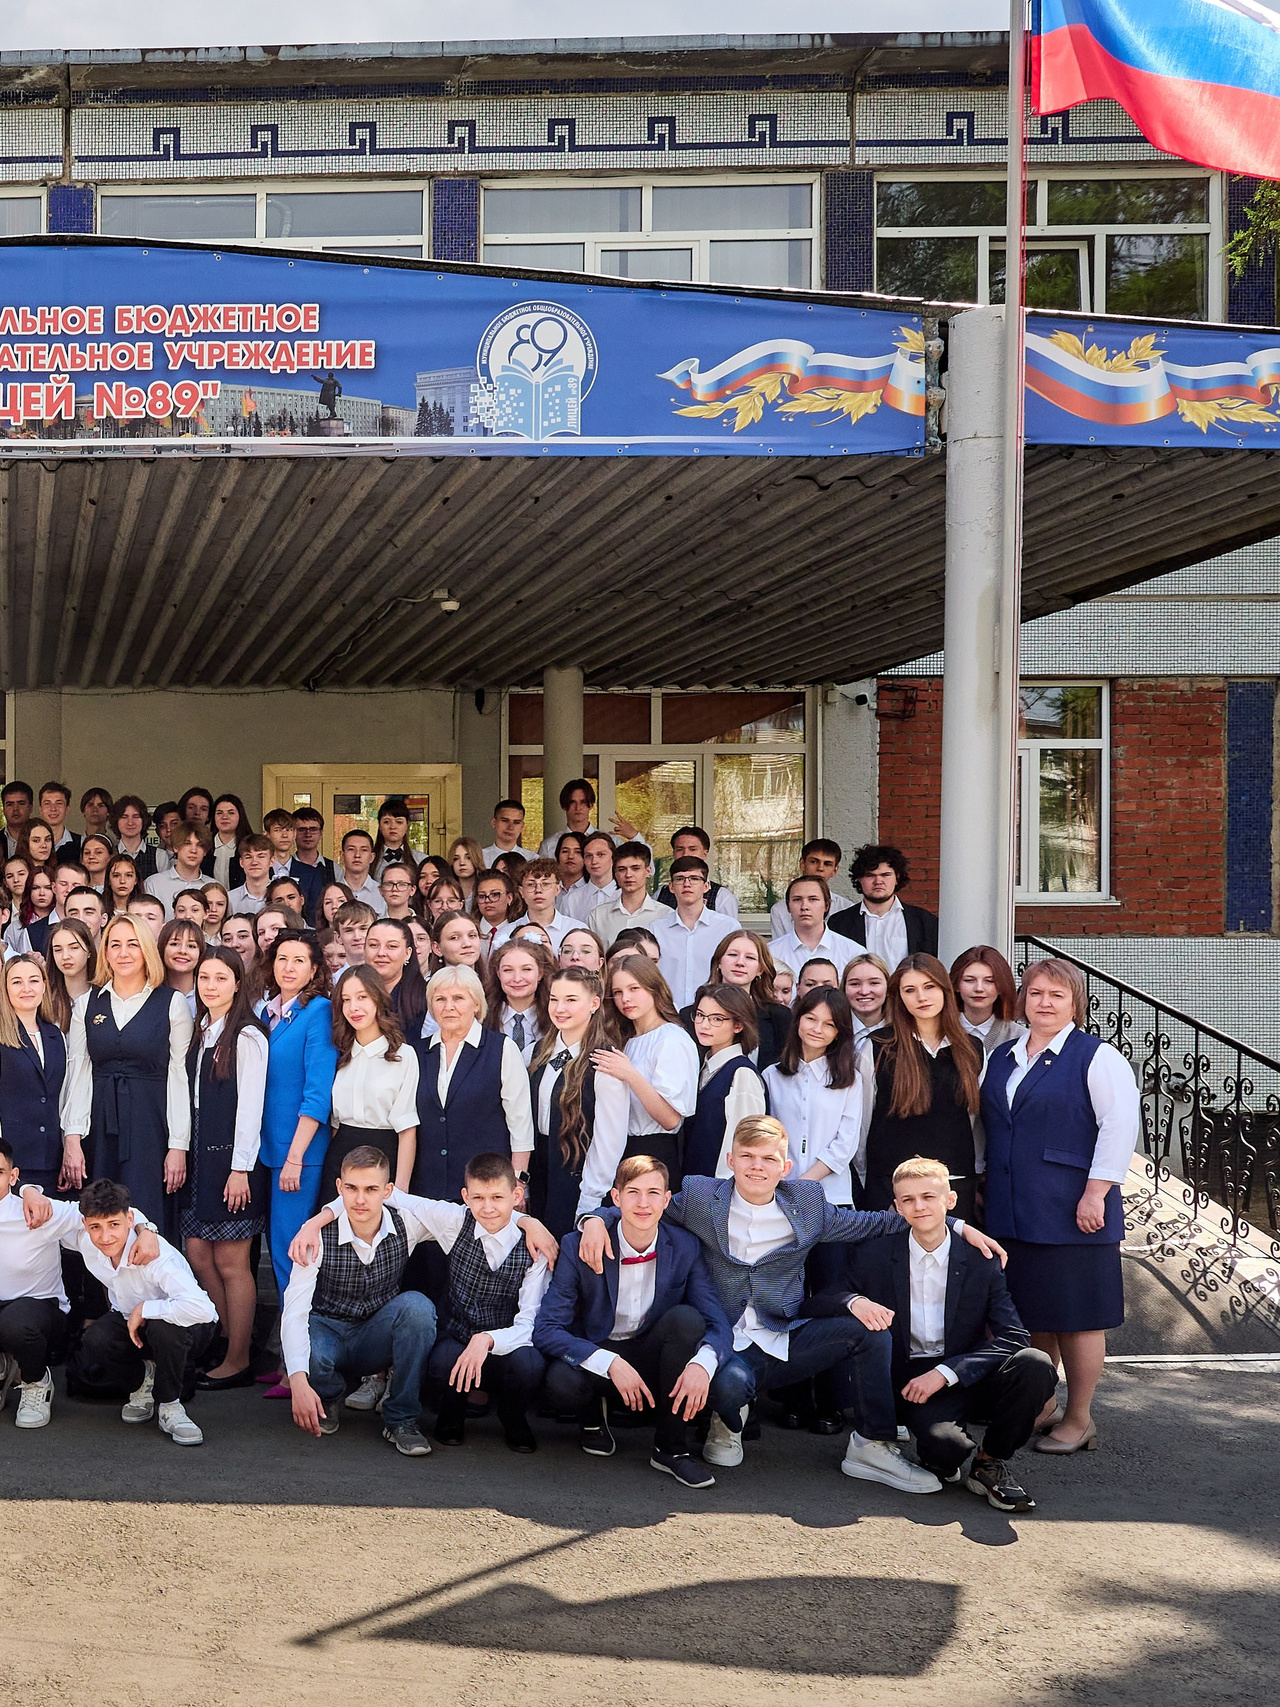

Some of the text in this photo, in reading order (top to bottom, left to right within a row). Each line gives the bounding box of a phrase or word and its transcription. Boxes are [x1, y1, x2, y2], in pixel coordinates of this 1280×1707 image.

[115, 304, 319, 337] БЮДЖЕТНОЕ
[163, 340, 375, 373] УЧРЕЖДЕНИЕ
[94, 381, 221, 418] №89"
